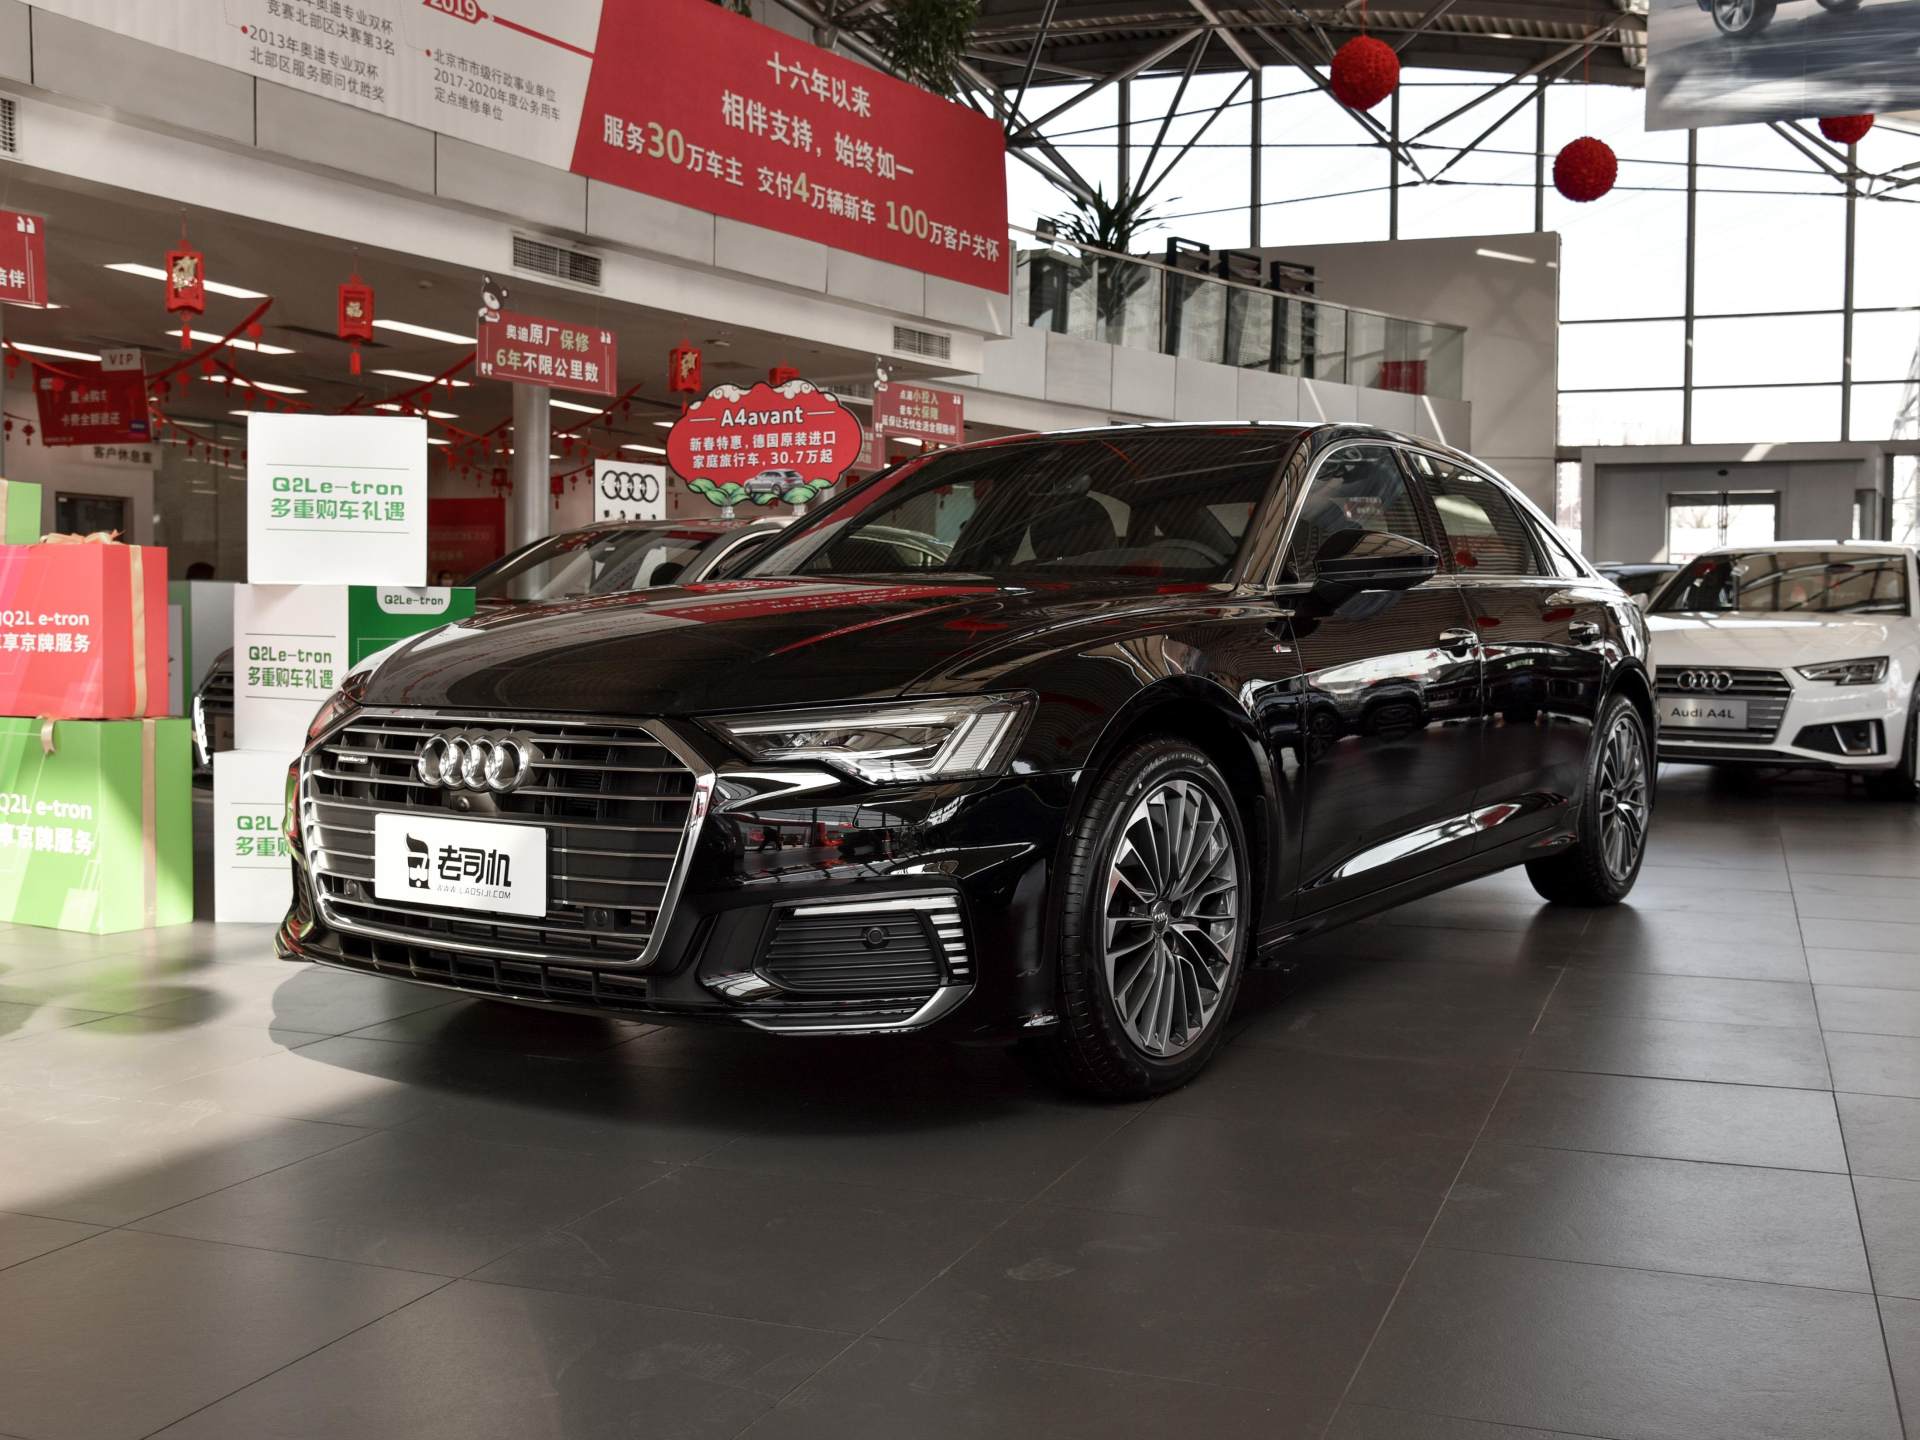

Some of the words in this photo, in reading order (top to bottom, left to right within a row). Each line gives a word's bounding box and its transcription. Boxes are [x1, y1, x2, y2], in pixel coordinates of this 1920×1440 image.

[250, 25, 379, 81] 2013年奥迪专业双杯
[250, 47, 385, 103] 北部区服务顾问优胜奖
[434, 49, 557, 102] 北京市市级行政事业单位
[767, 52, 871, 118] 十六年以来
[434, 68, 560, 120] 2017-2020年度公务用车
[434, 87, 504, 121] 定点维修单位
[603, 114, 745, 187] 服务30万车主
[757, 166, 876, 225] 交付4万辆新车
[886, 201, 1000, 262] 100万客户关怀
[506, 323, 590, 352] 奥迪原厂保修
[109, 353, 133, 365] VIP
[496, 349, 599, 383] 6年不限公里数
[721, 406, 804, 427] A4avant
[271, 498, 405, 520] 多重购车礼遇
[0, 610, 35, 627] Q2L
[38, 613, 90, 626] e-tron
[0, 632, 91, 653] 享京牌服务
[248, 666, 334, 689] 多重购车礼遇
[1671, 707, 1703, 718] Audi
[1706, 708, 1735, 719] A4L
[36, 799, 93, 820] e-tron
[437, 845, 512, 887] 老司机
